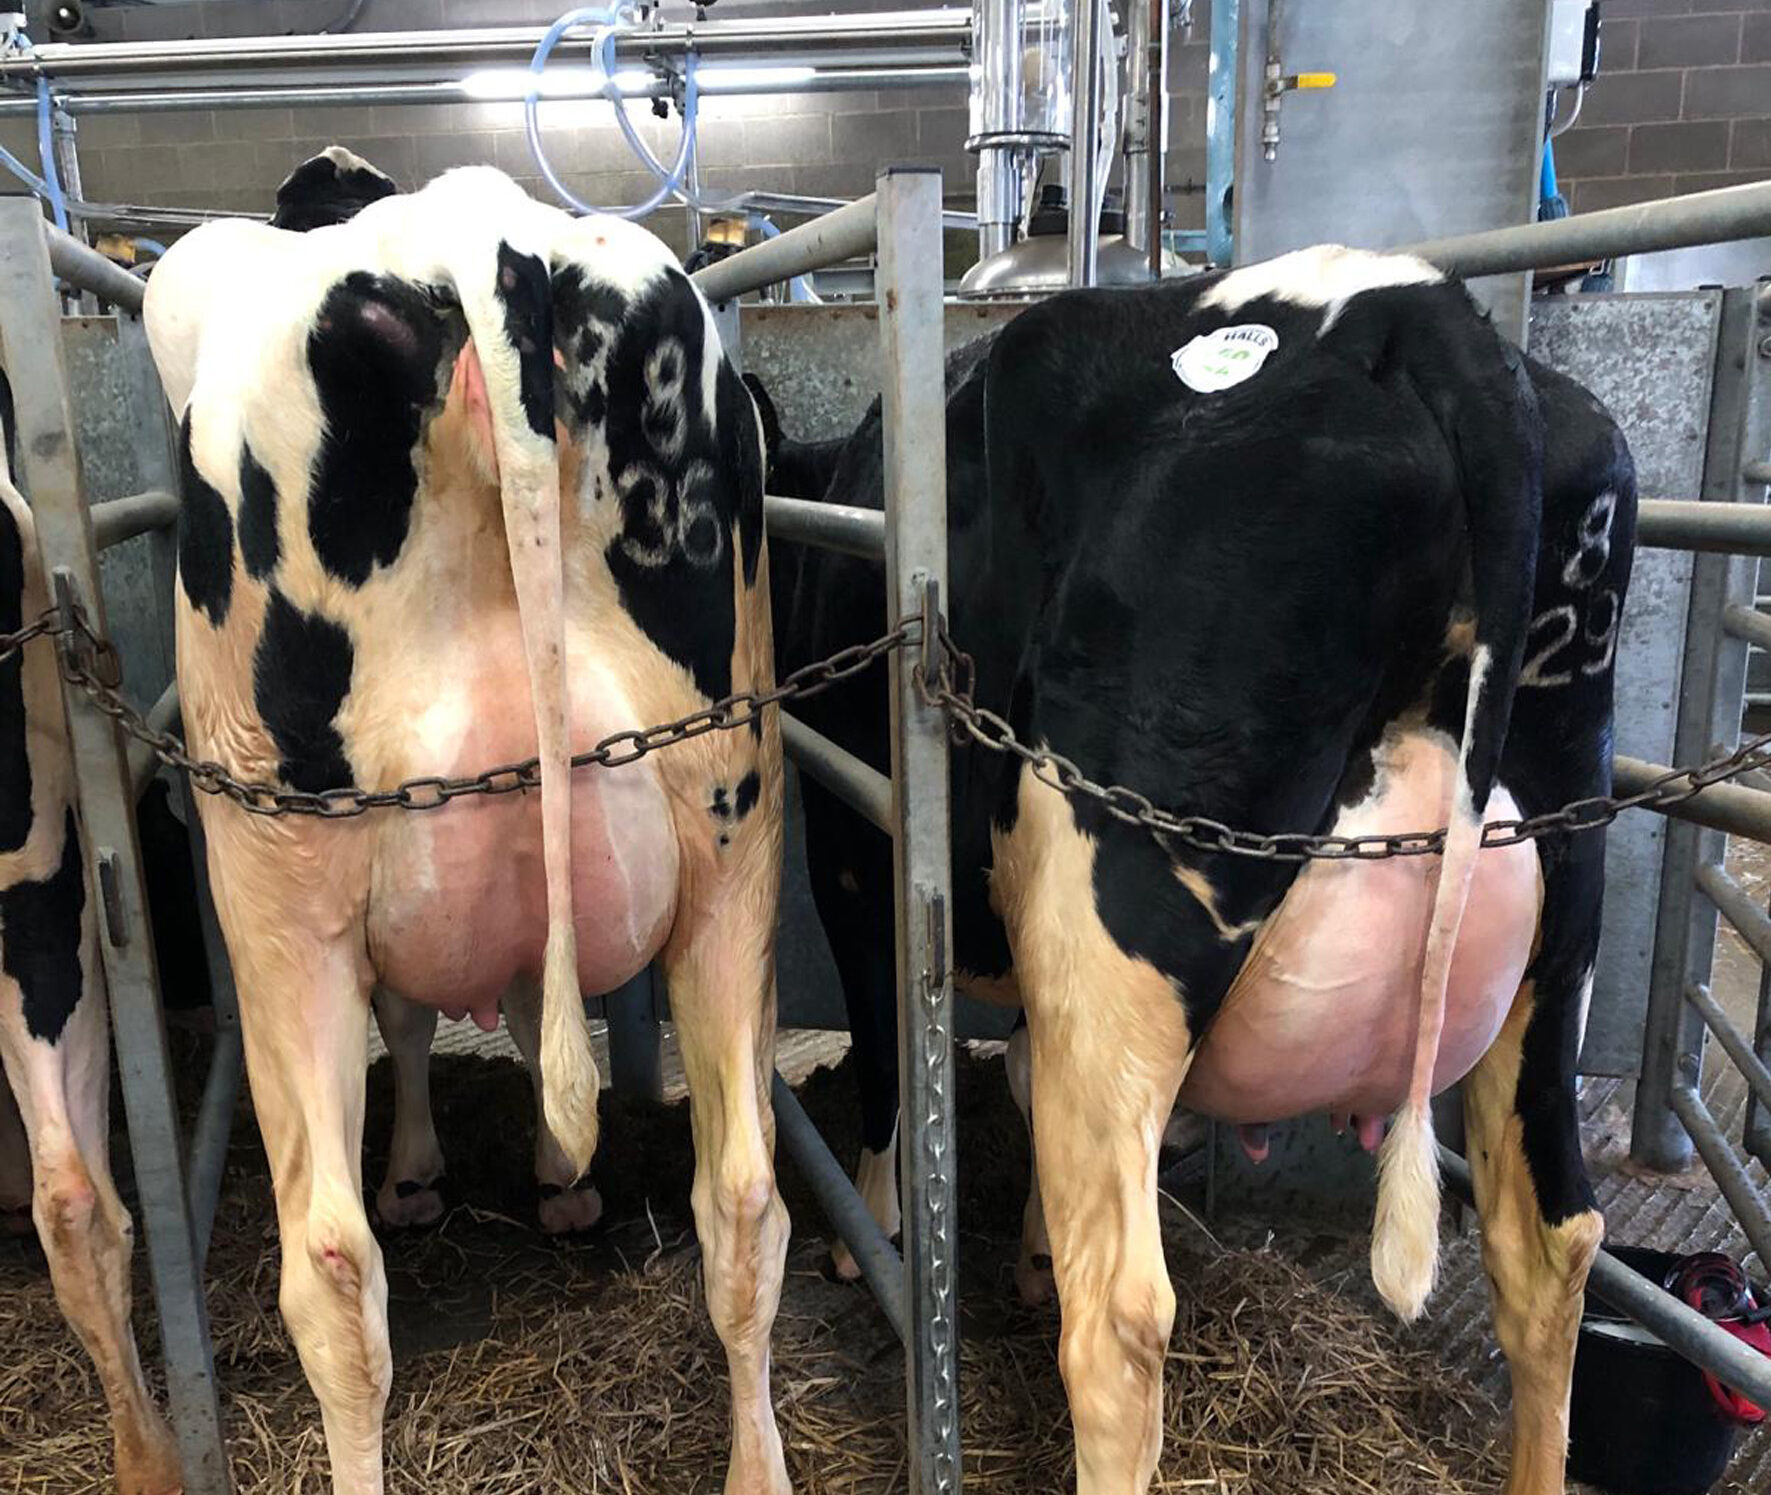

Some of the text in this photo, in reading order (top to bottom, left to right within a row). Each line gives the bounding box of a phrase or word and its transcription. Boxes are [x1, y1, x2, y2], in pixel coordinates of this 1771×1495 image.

[1224, 330, 1268, 347] HALLS
[642, 338, 688, 460] 8
[617, 457, 723, 568] 36
[1518, 589, 1619, 686] 29
